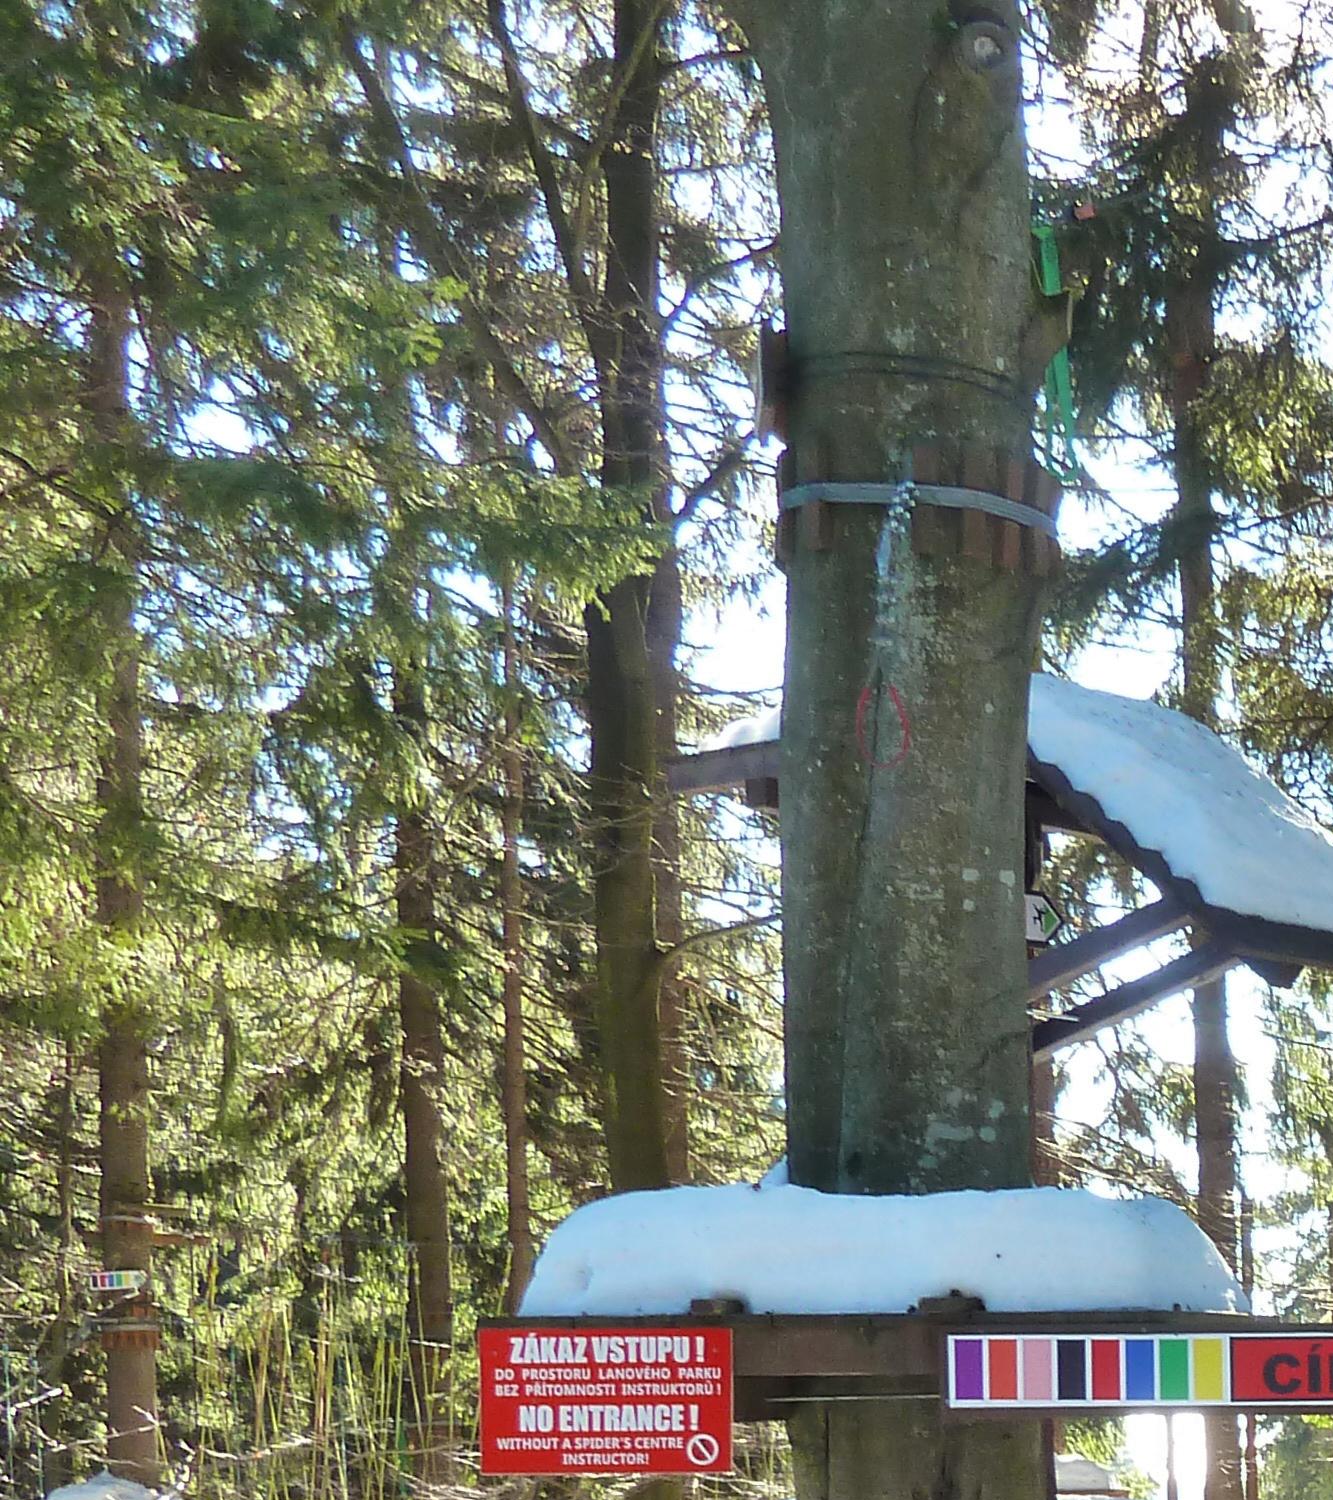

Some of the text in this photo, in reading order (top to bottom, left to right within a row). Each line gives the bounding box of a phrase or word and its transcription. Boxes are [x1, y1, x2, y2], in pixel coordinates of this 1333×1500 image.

[509, 1333, 705, 1364] ZÁKAZ VSTUPU !
[494, 1365, 721, 1380] DO PROSTORU LANOVÉHO PARKU
[494, 1385, 519, 1397] BEZ
[525, 1382, 616, 1397] PŘÍTOMNOSTI
[622, 1381, 714, 1396] INSTRUKTORŮ
[519, 1404, 699, 1432] NO ENTRANCE !
[497, 1437, 684, 1450] WITHOUT A SPIDER'S CENTRE
[562, 1453, 649, 1465] INSTRUCTOR!
